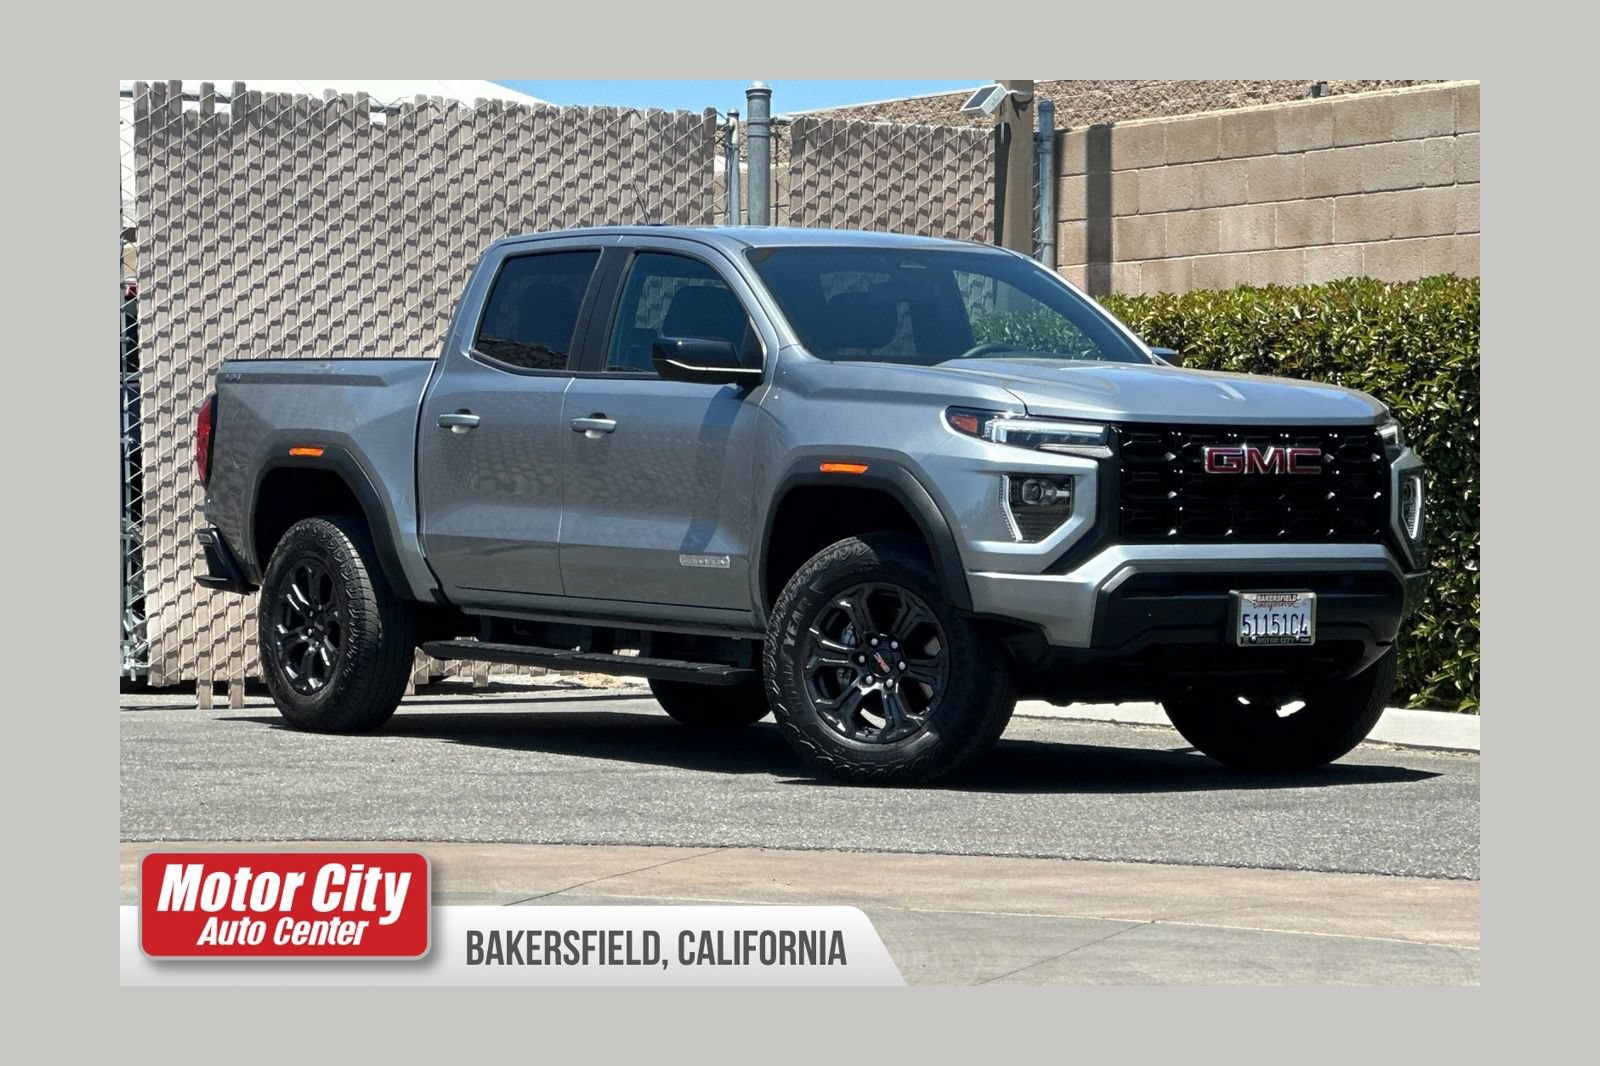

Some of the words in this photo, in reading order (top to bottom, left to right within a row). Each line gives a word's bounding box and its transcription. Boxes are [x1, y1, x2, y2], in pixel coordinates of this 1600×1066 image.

[1204, 444, 1322, 475] GMC
[1256, 594, 1298, 602] BAKERSFIELD
[1242, 613, 1308, 636] 51151C4
